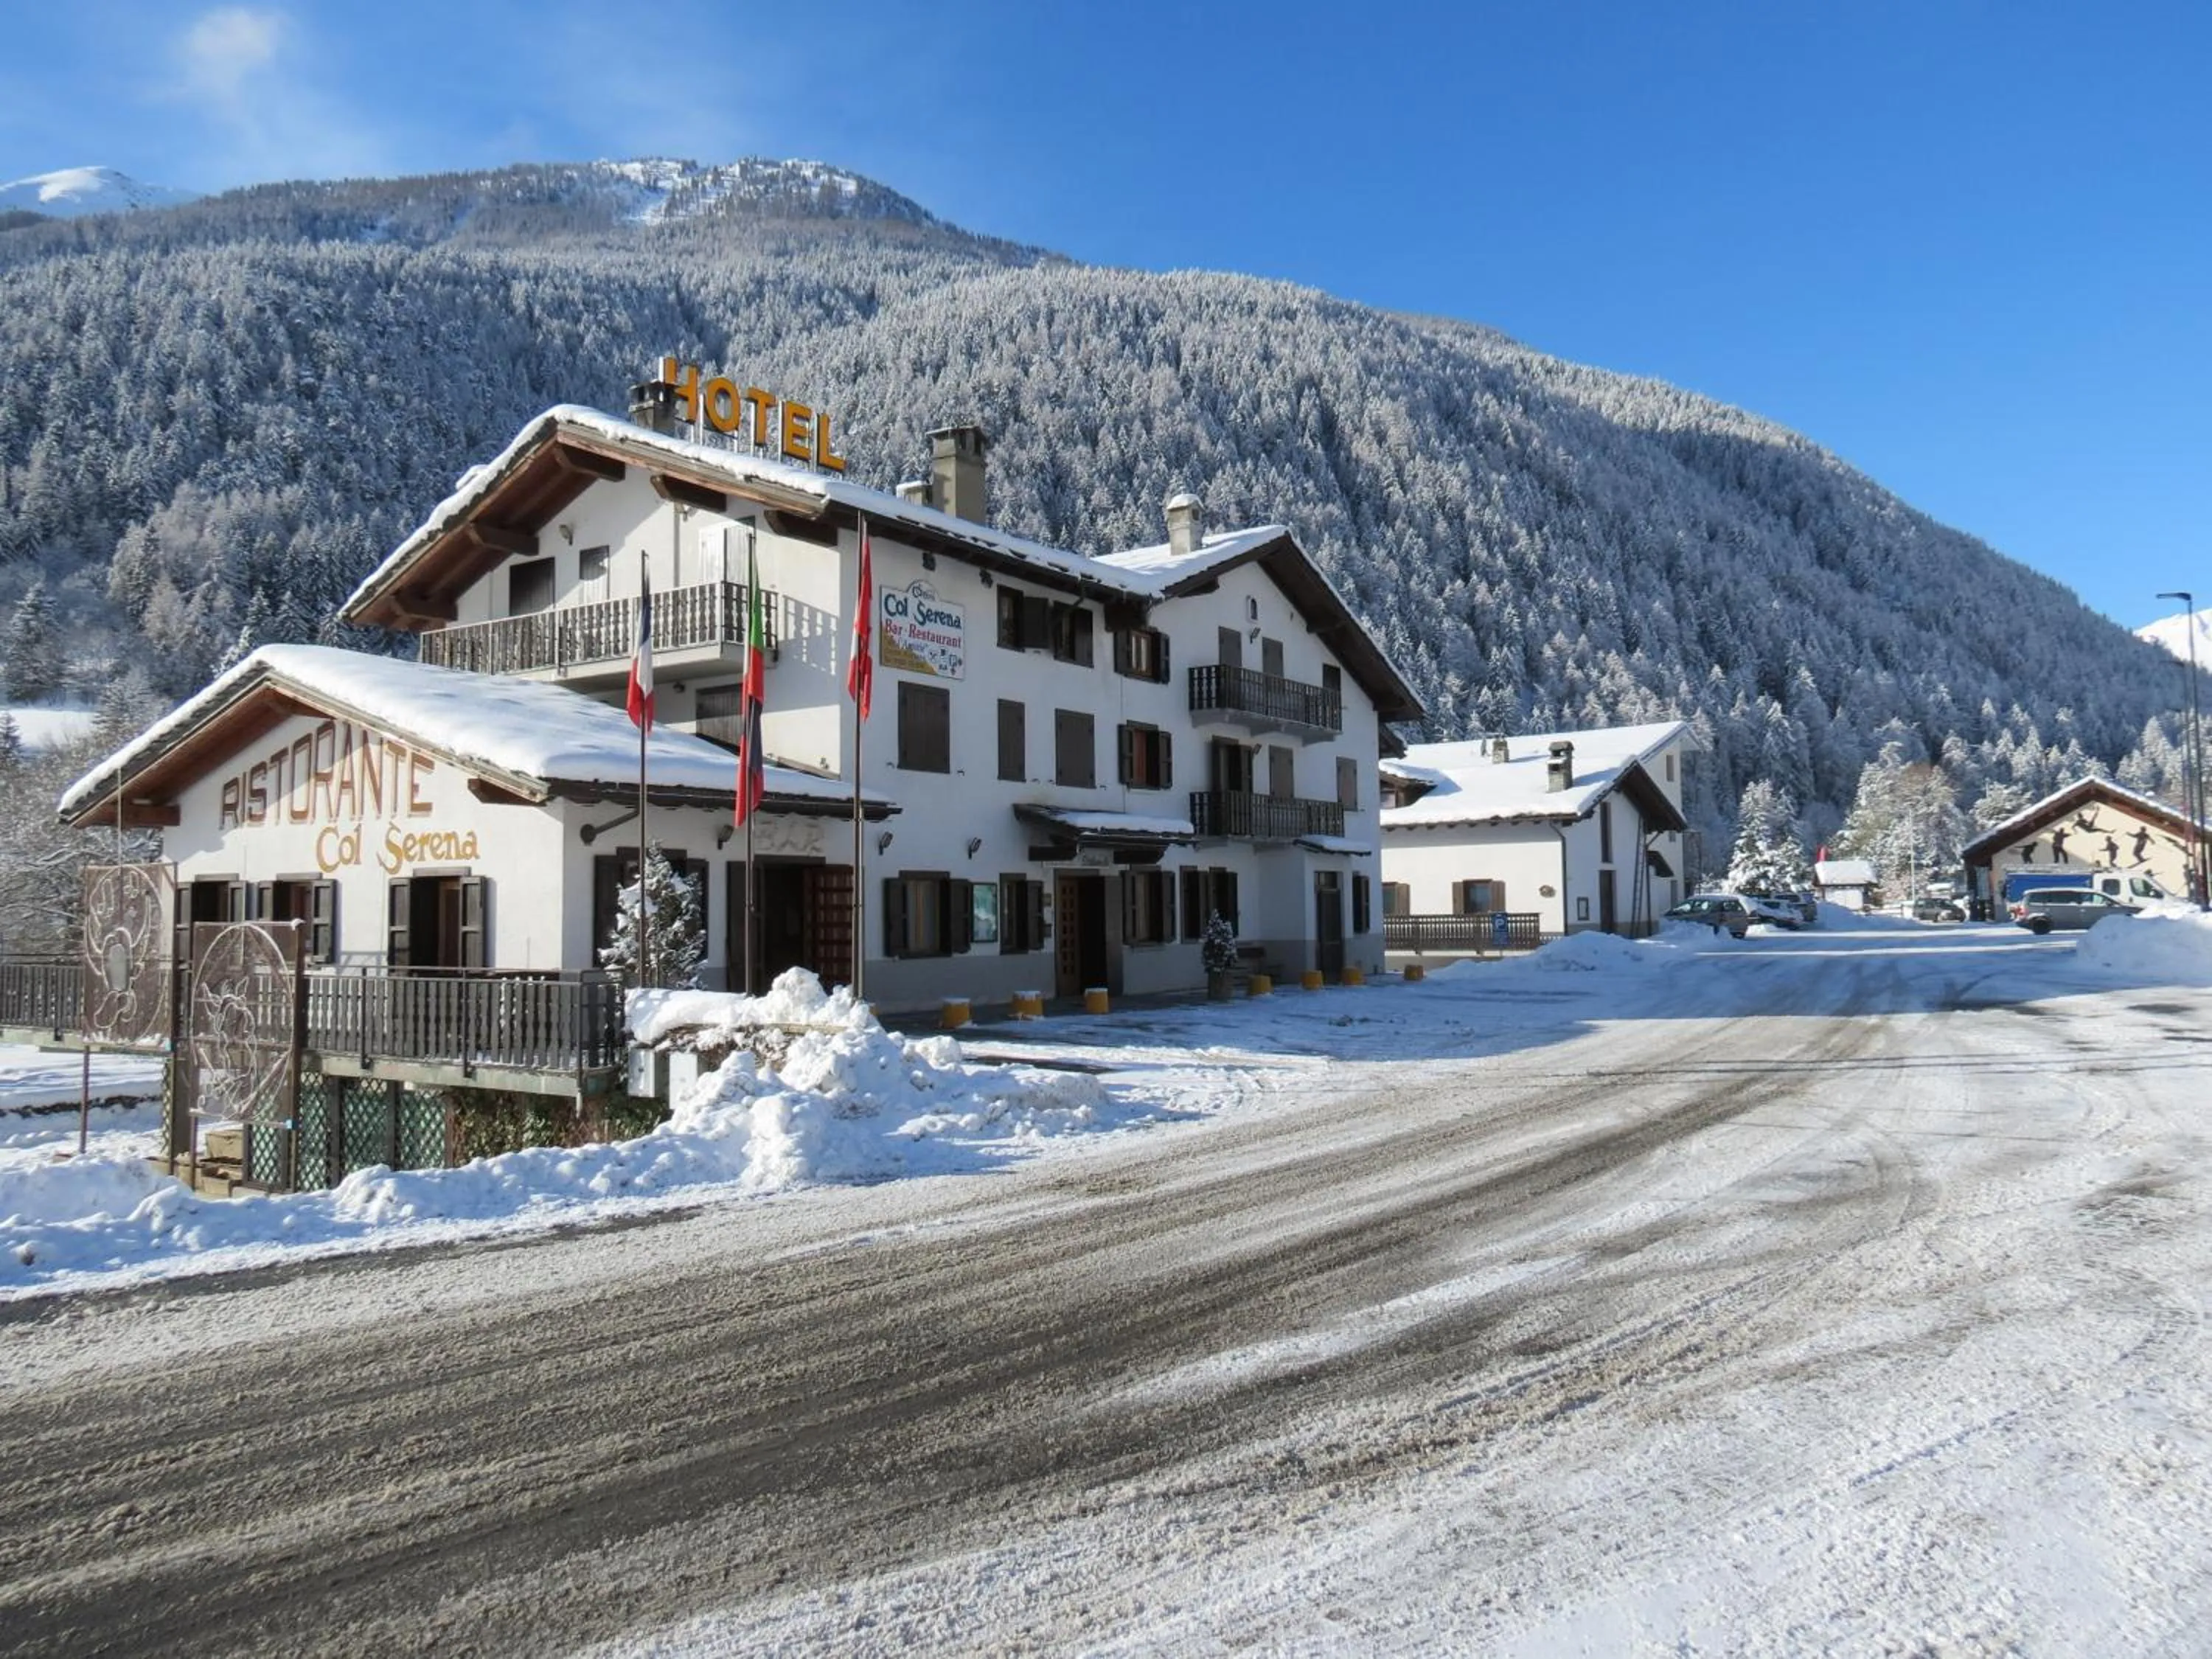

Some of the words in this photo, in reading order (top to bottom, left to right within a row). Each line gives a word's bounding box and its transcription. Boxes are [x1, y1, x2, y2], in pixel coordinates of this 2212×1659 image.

[663, 356, 847, 472] HOTEL
[885, 593, 908, 617] Col
[914, 600, 961, 629] Serena
[886, 619, 903, 636] Bar
[908, 624, 961, 648] Restaurant
[219, 720, 435, 830] RISTORANTE
[316, 824, 362, 874] Col
[377, 821, 480, 874] Serena
